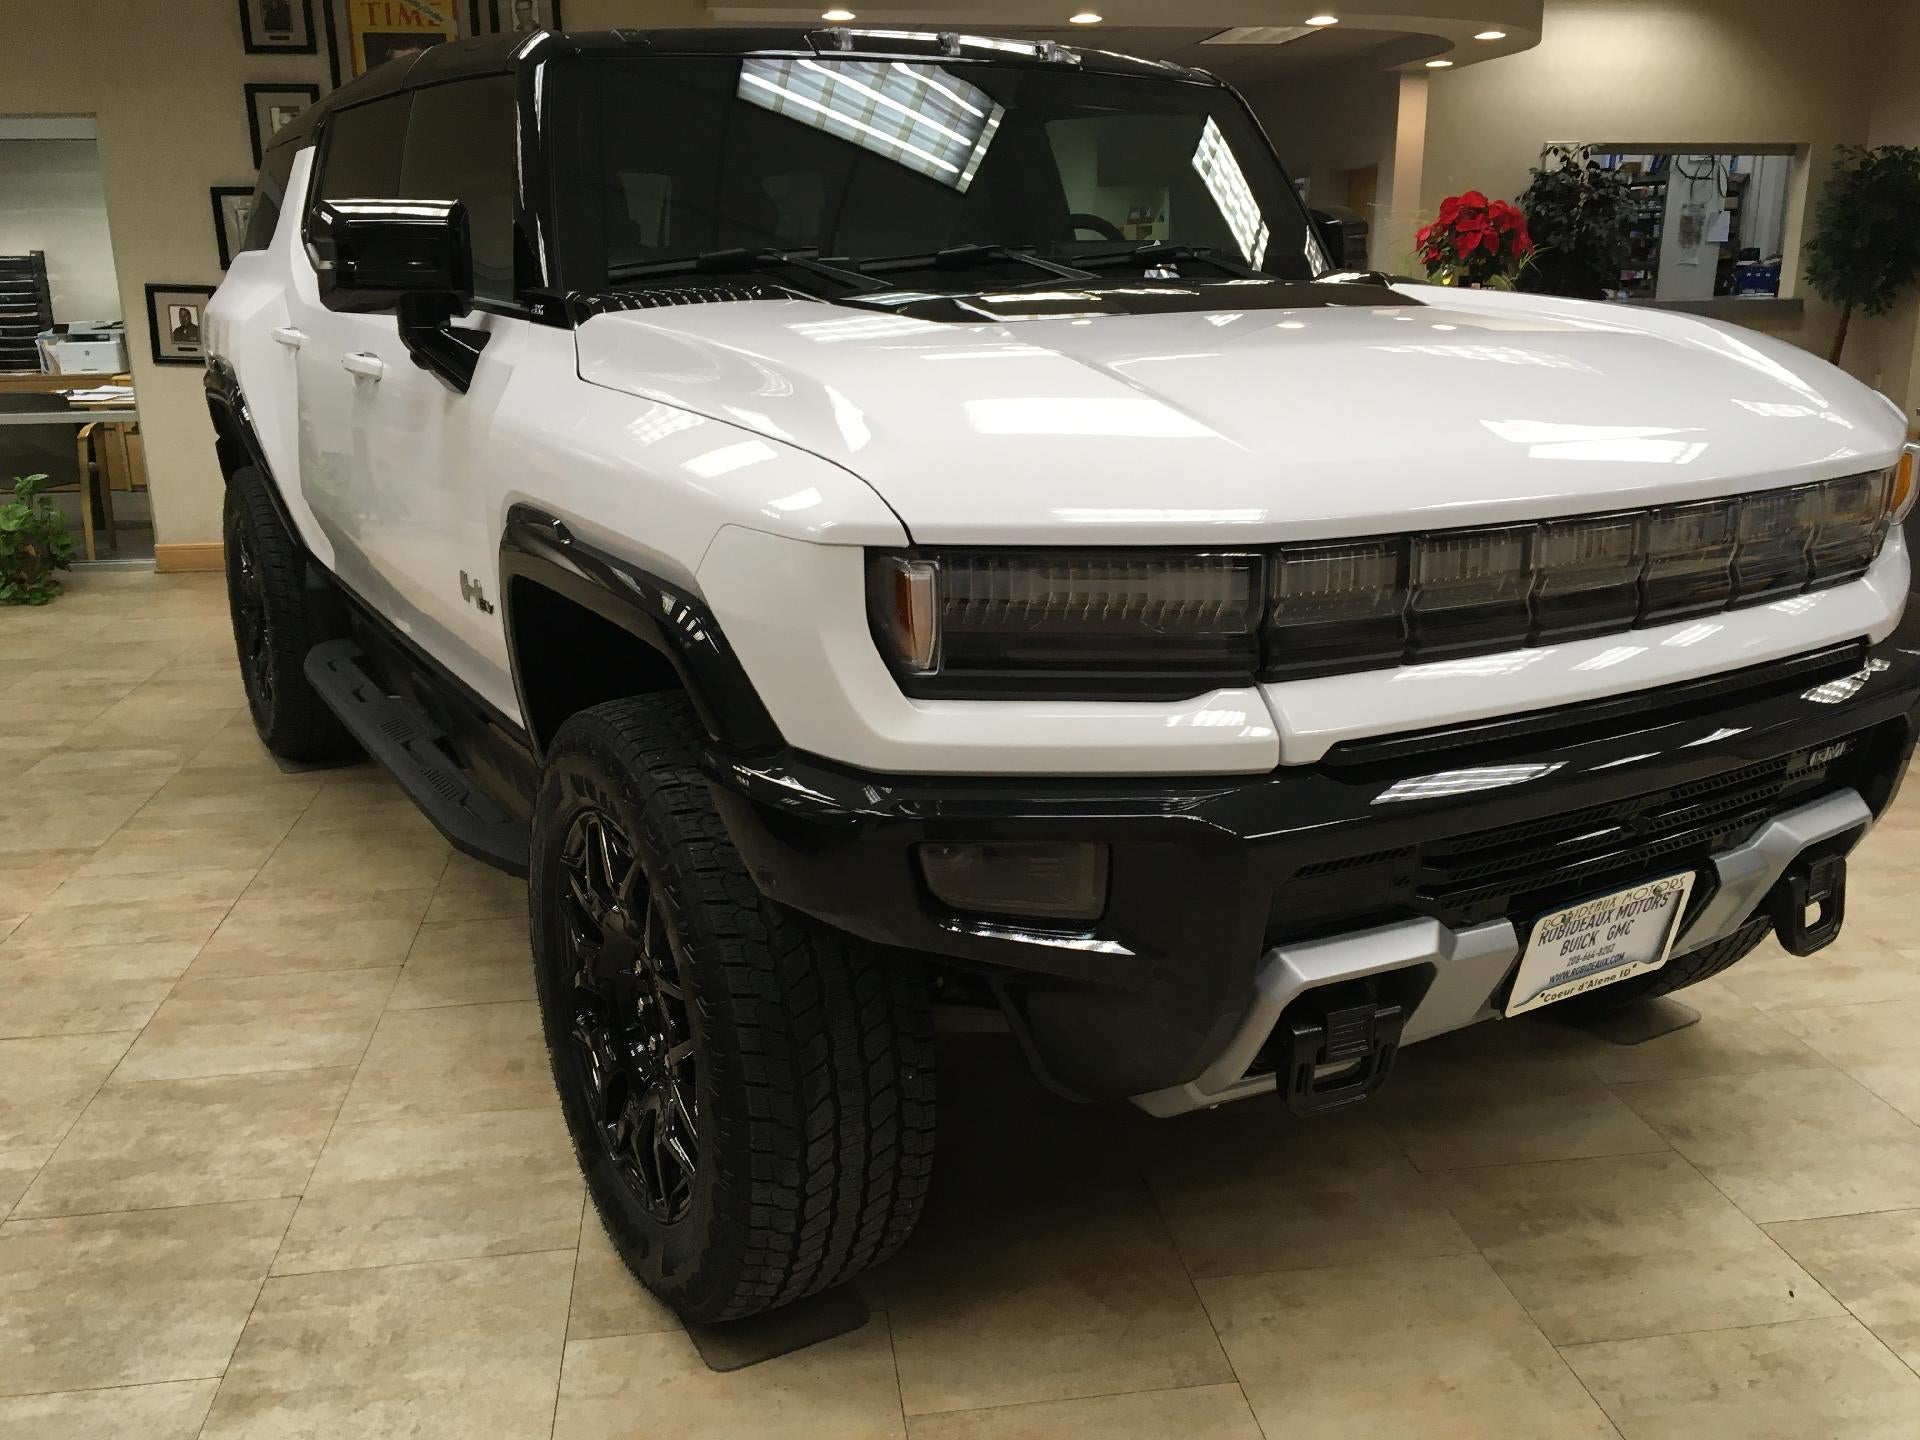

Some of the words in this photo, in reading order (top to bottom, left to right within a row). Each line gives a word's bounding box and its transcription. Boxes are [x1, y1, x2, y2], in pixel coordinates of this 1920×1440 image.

[1538, 909, 1616, 946] ROBIDEAUX
[1615, 892, 1671, 921] MOTORS
[1560, 931, 1600, 956] BUICK
[1607, 919, 1635, 941] GMC
